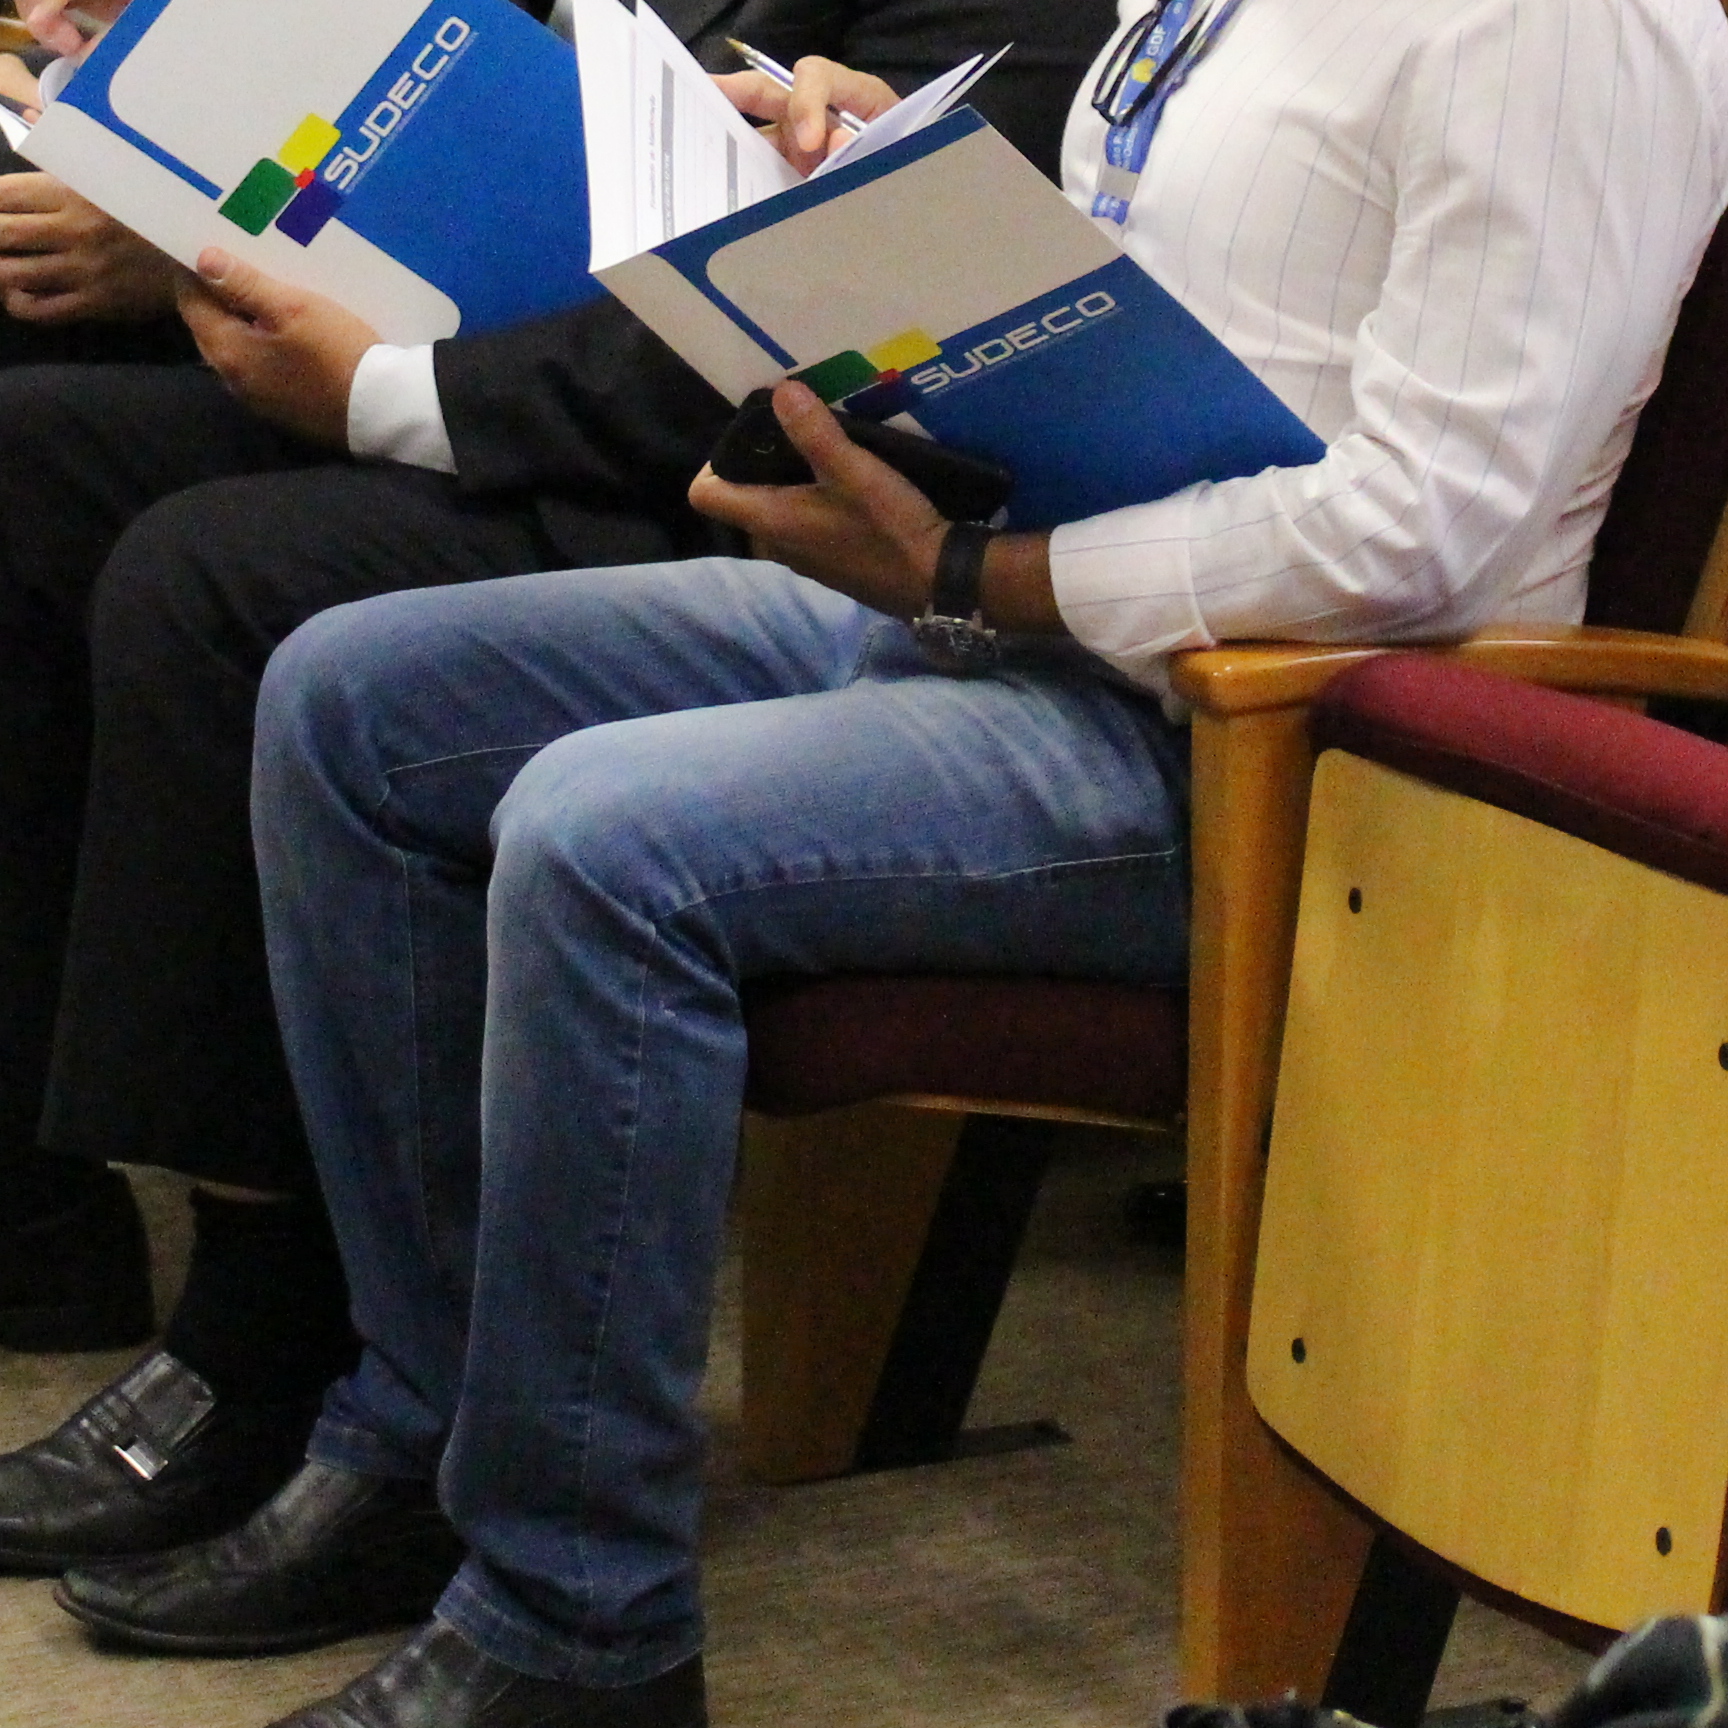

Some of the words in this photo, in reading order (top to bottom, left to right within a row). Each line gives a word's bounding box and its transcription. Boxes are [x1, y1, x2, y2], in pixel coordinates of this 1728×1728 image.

[1145, 24, 1166, 57] GDF
[323, 16, 471, 190] SUDECO
[910, 291, 1116, 395] SUDECO
